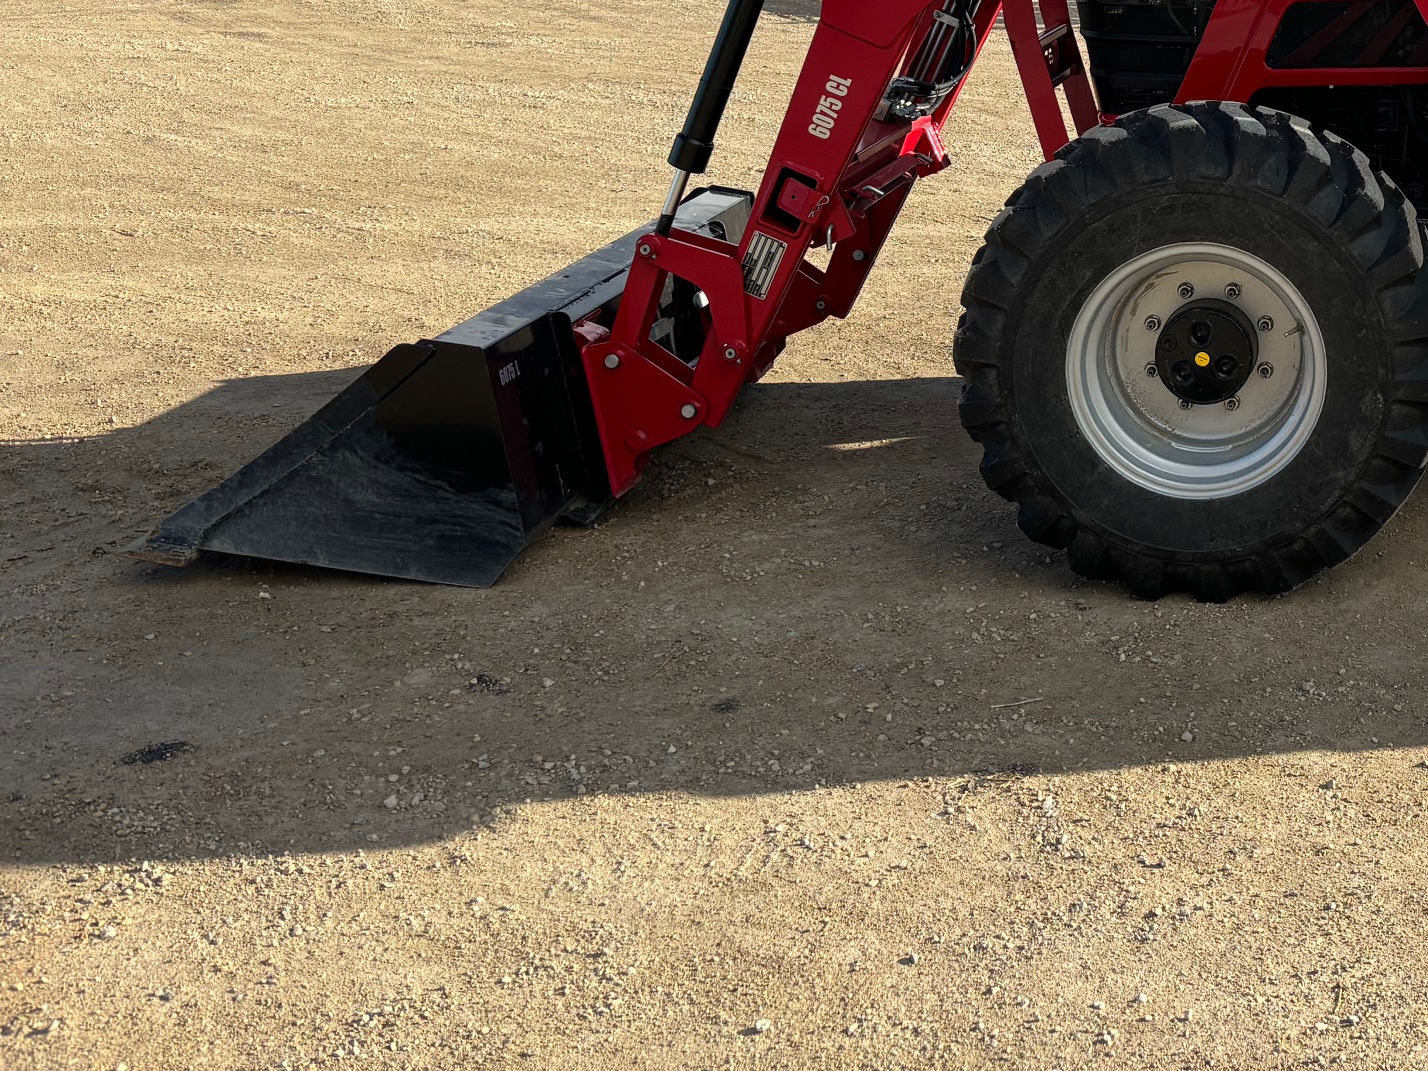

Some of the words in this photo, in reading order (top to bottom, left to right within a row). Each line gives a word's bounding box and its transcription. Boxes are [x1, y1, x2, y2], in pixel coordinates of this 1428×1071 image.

[808, 95, 843, 140] 6075
[826, 74, 853, 97] CL
[499, 362, 516, 386] 6075
